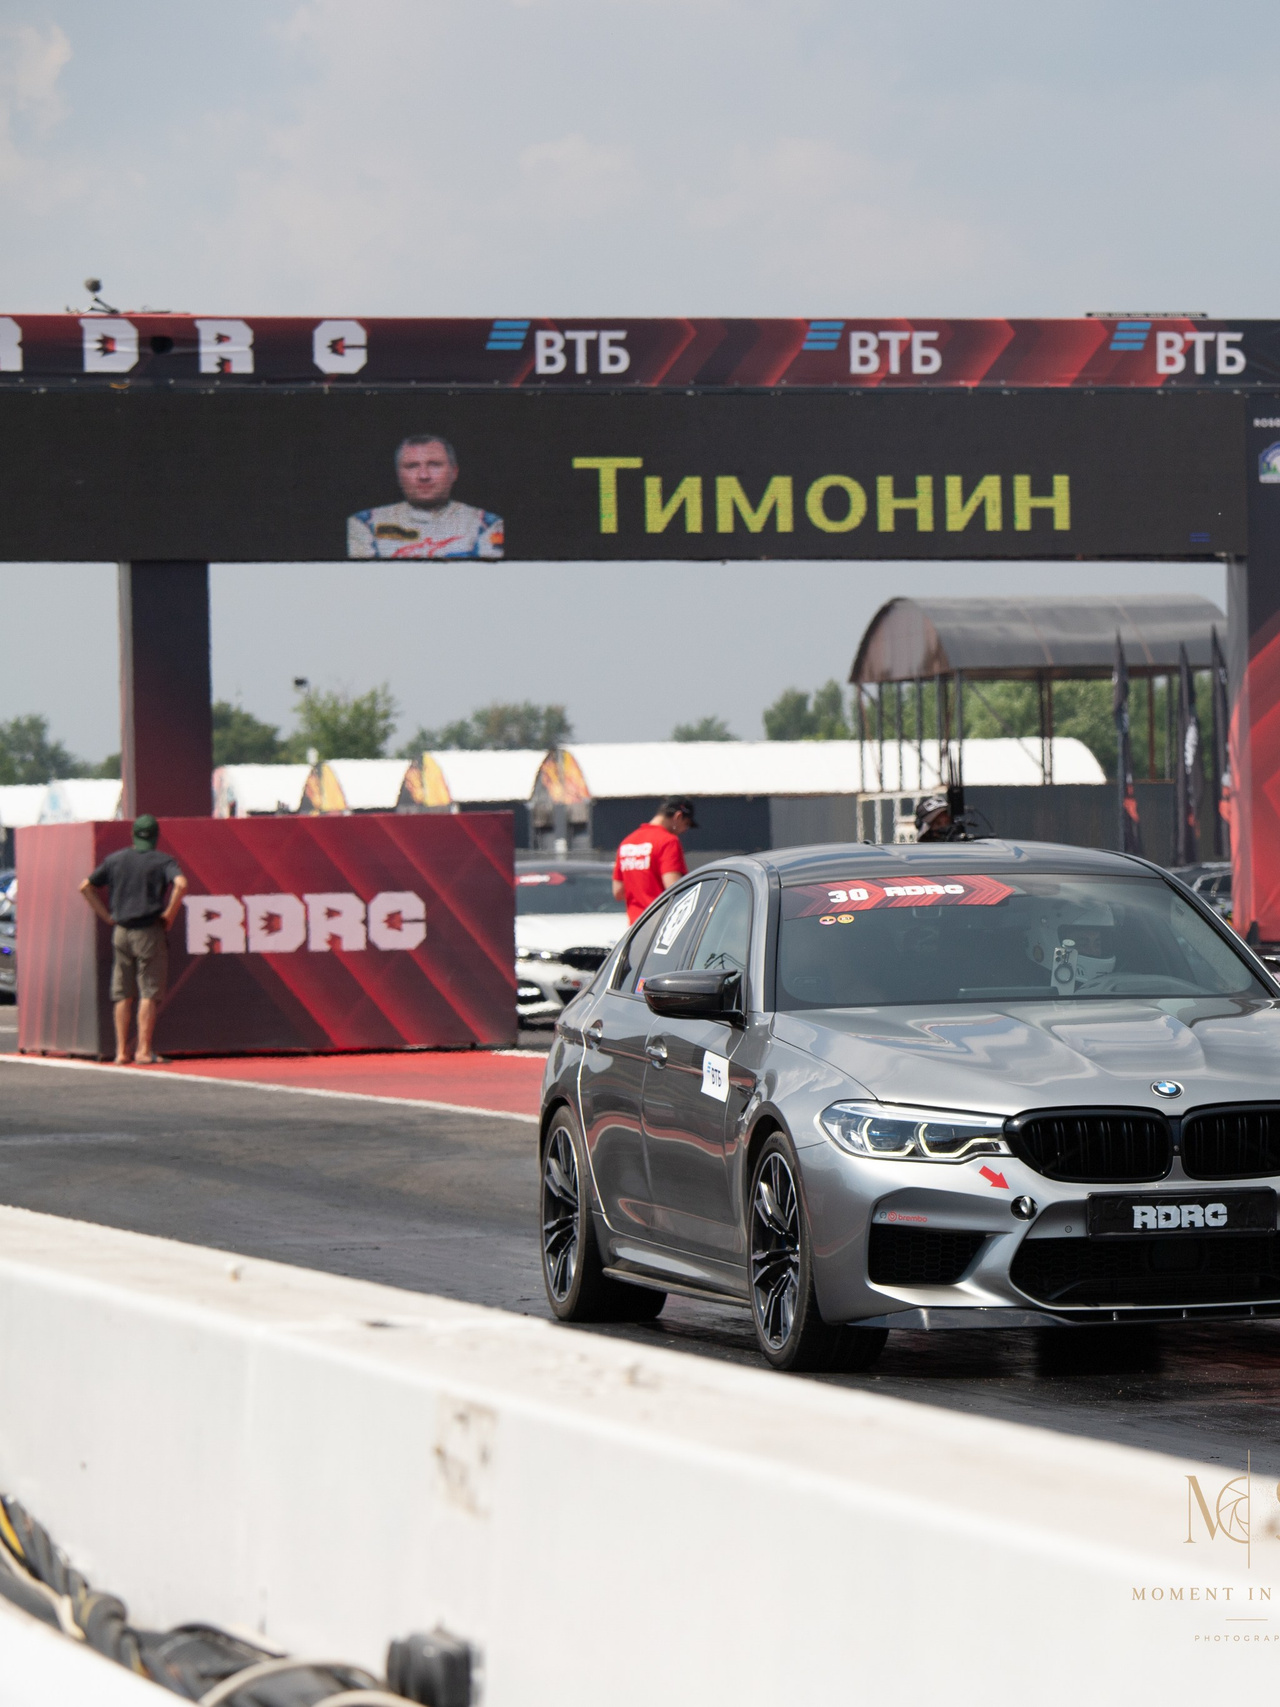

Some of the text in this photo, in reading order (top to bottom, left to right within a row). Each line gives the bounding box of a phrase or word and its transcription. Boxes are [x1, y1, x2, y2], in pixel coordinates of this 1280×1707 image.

[534, 329, 631, 375] ВТБ
[848, 330, 942, 375] ВТБ
[1155, 330, 1247, 375] ВТБ
[572, 457, 1071, 534] Тимонин
[828, 884, 965, 903] 30 RDRC
[185, 891, 427, 954] RDRC
[711, 1067, 722, 1087] ВТБ
[898, 1214, 928, 1223] brembo
[1132, 1203, 1228, 1229] RDRC
